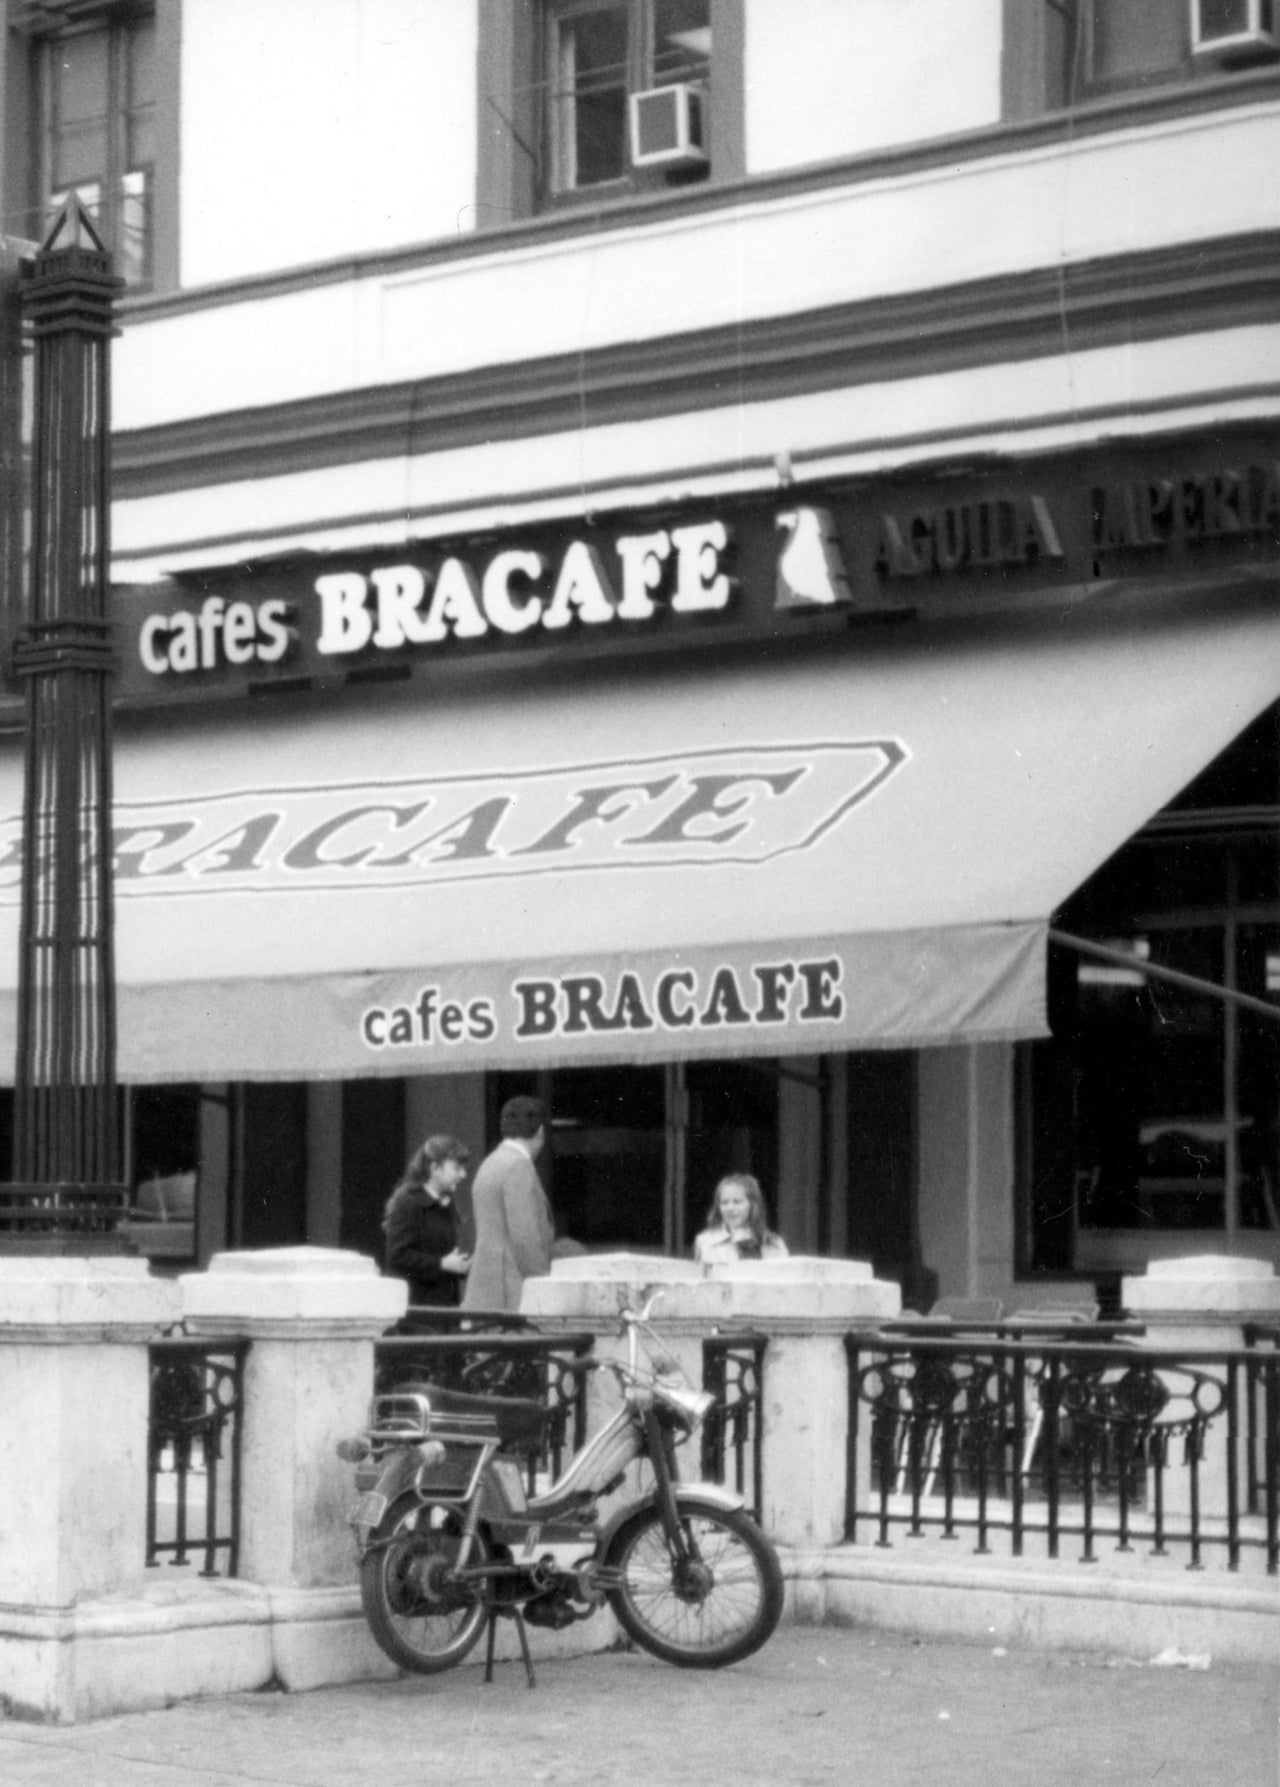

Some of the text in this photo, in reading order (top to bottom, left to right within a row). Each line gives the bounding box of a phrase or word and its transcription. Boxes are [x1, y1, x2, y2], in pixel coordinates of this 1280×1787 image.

[138, 520, 730, 673] cafes BRACAFE
[363, 958, 844, 1045] cafes BRACAFE
